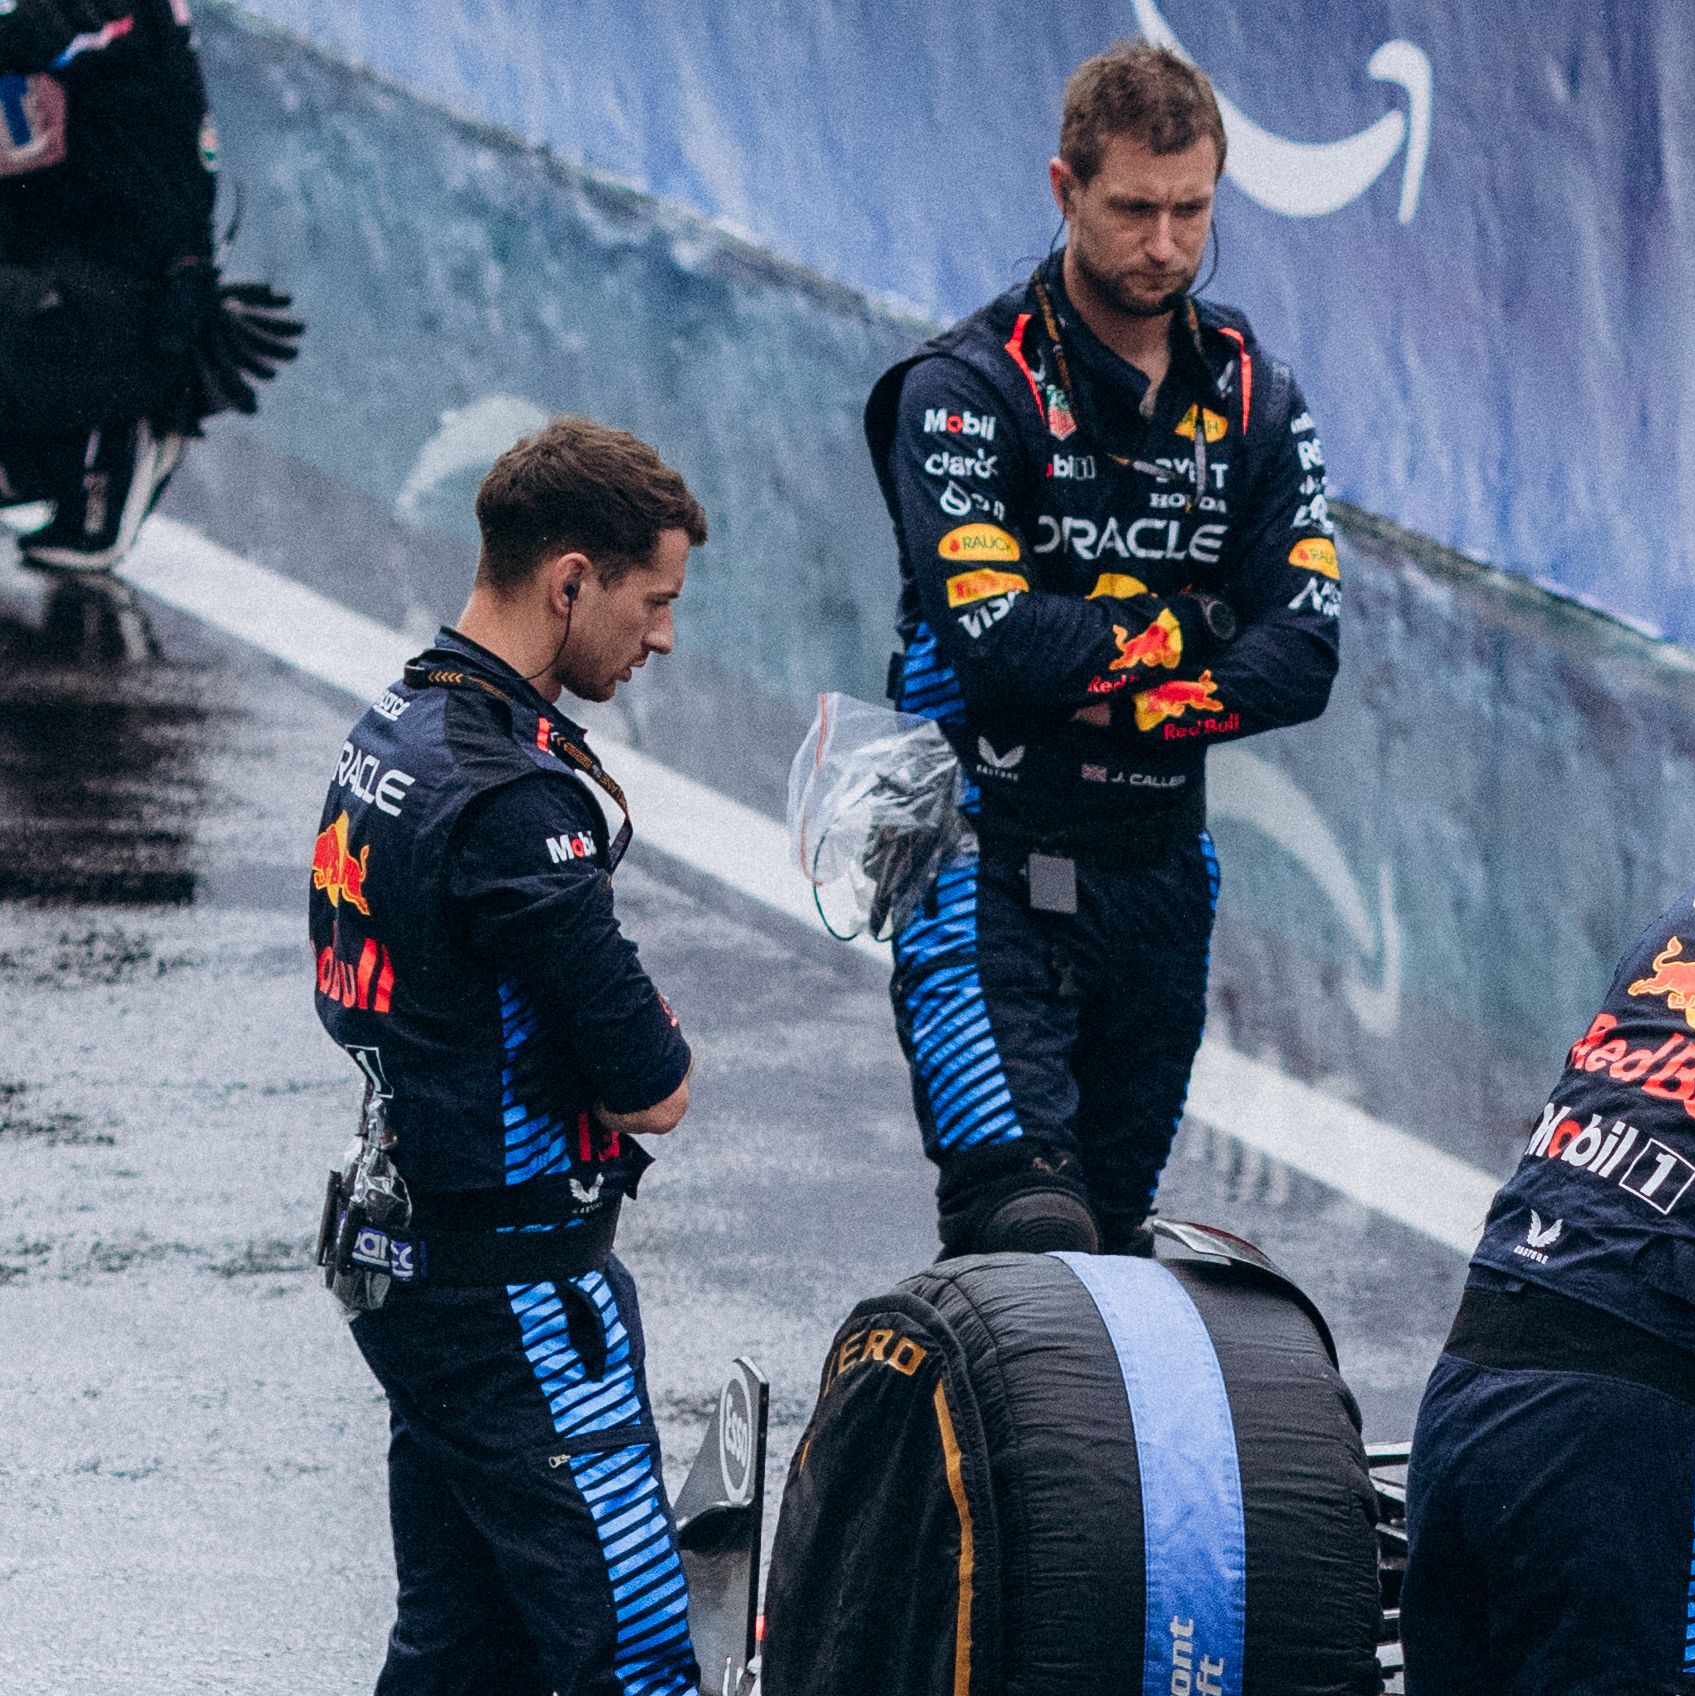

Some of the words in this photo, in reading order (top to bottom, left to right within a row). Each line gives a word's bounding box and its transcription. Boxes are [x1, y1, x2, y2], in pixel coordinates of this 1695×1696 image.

[924, 408, 996, 441] Mobil
[924, 448, 998, 479] claro
[1150, 492, 1227, 513] HODA
[332, 740, 416, 817] RACLE
[1525, 1102, 1640, 1179] Mobil
[726, 1392, 748, 1468] Esso
